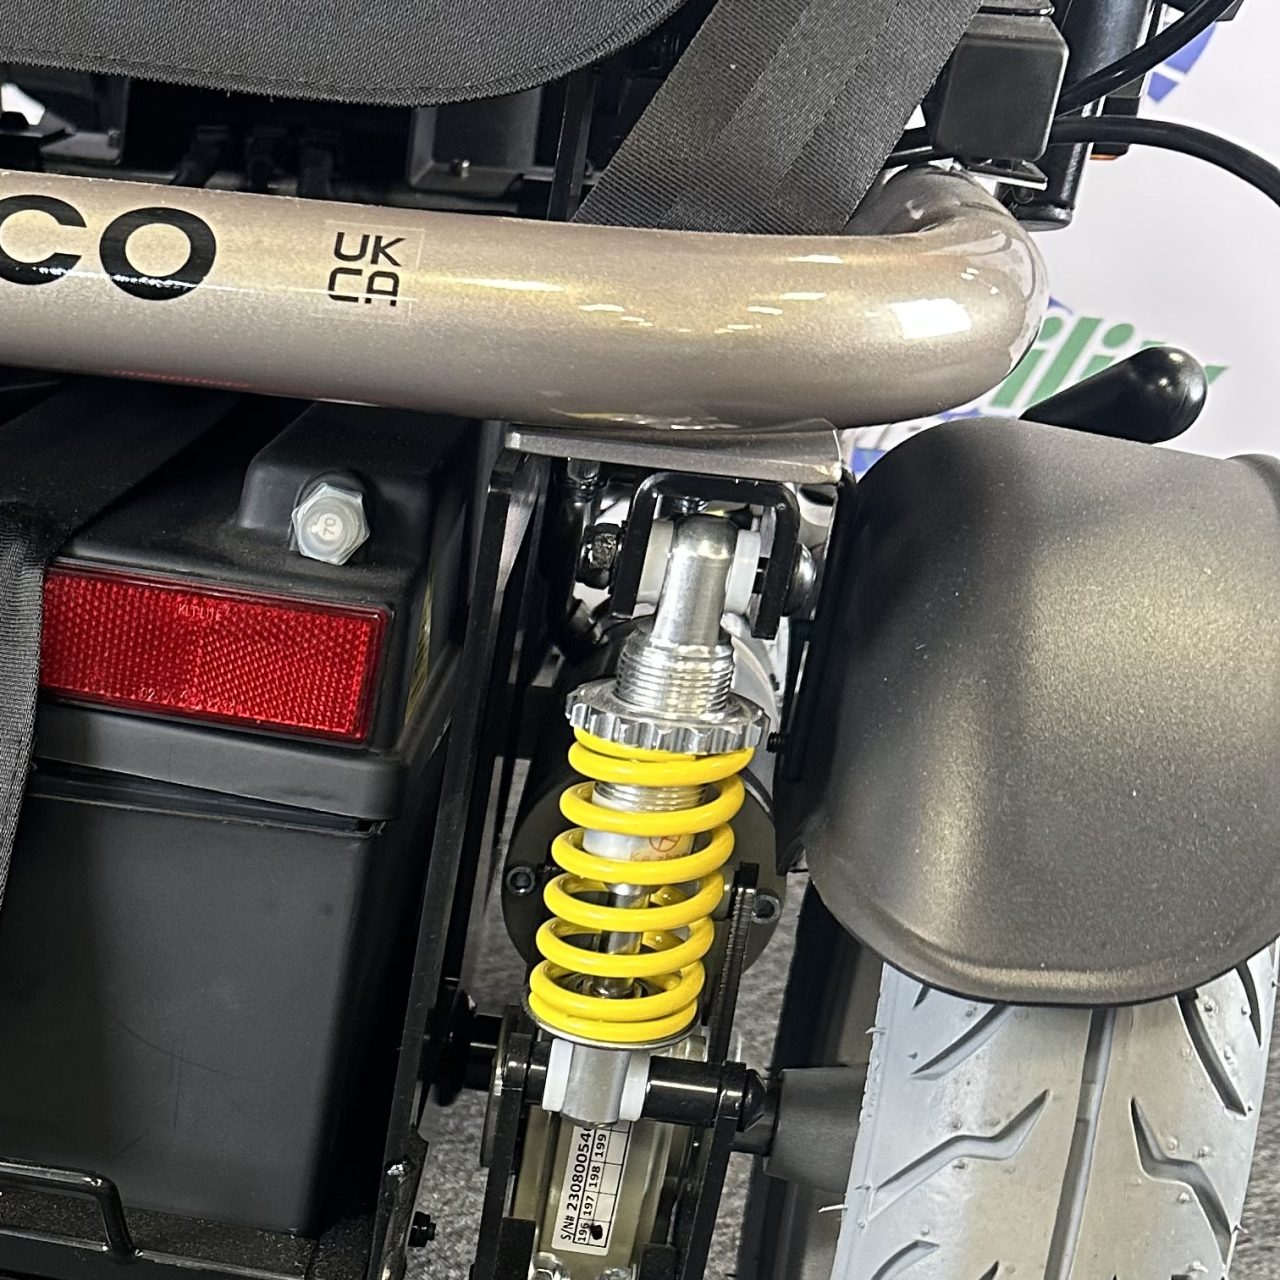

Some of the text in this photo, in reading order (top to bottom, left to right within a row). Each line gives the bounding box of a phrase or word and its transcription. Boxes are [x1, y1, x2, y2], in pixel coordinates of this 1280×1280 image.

[333, 231, 405, 270] UK
[326, 266, 400, 308] CA
[577, 1133, 607, 1242] 196 197 198 199
[560, 1215, 576, 1241] S/N#
